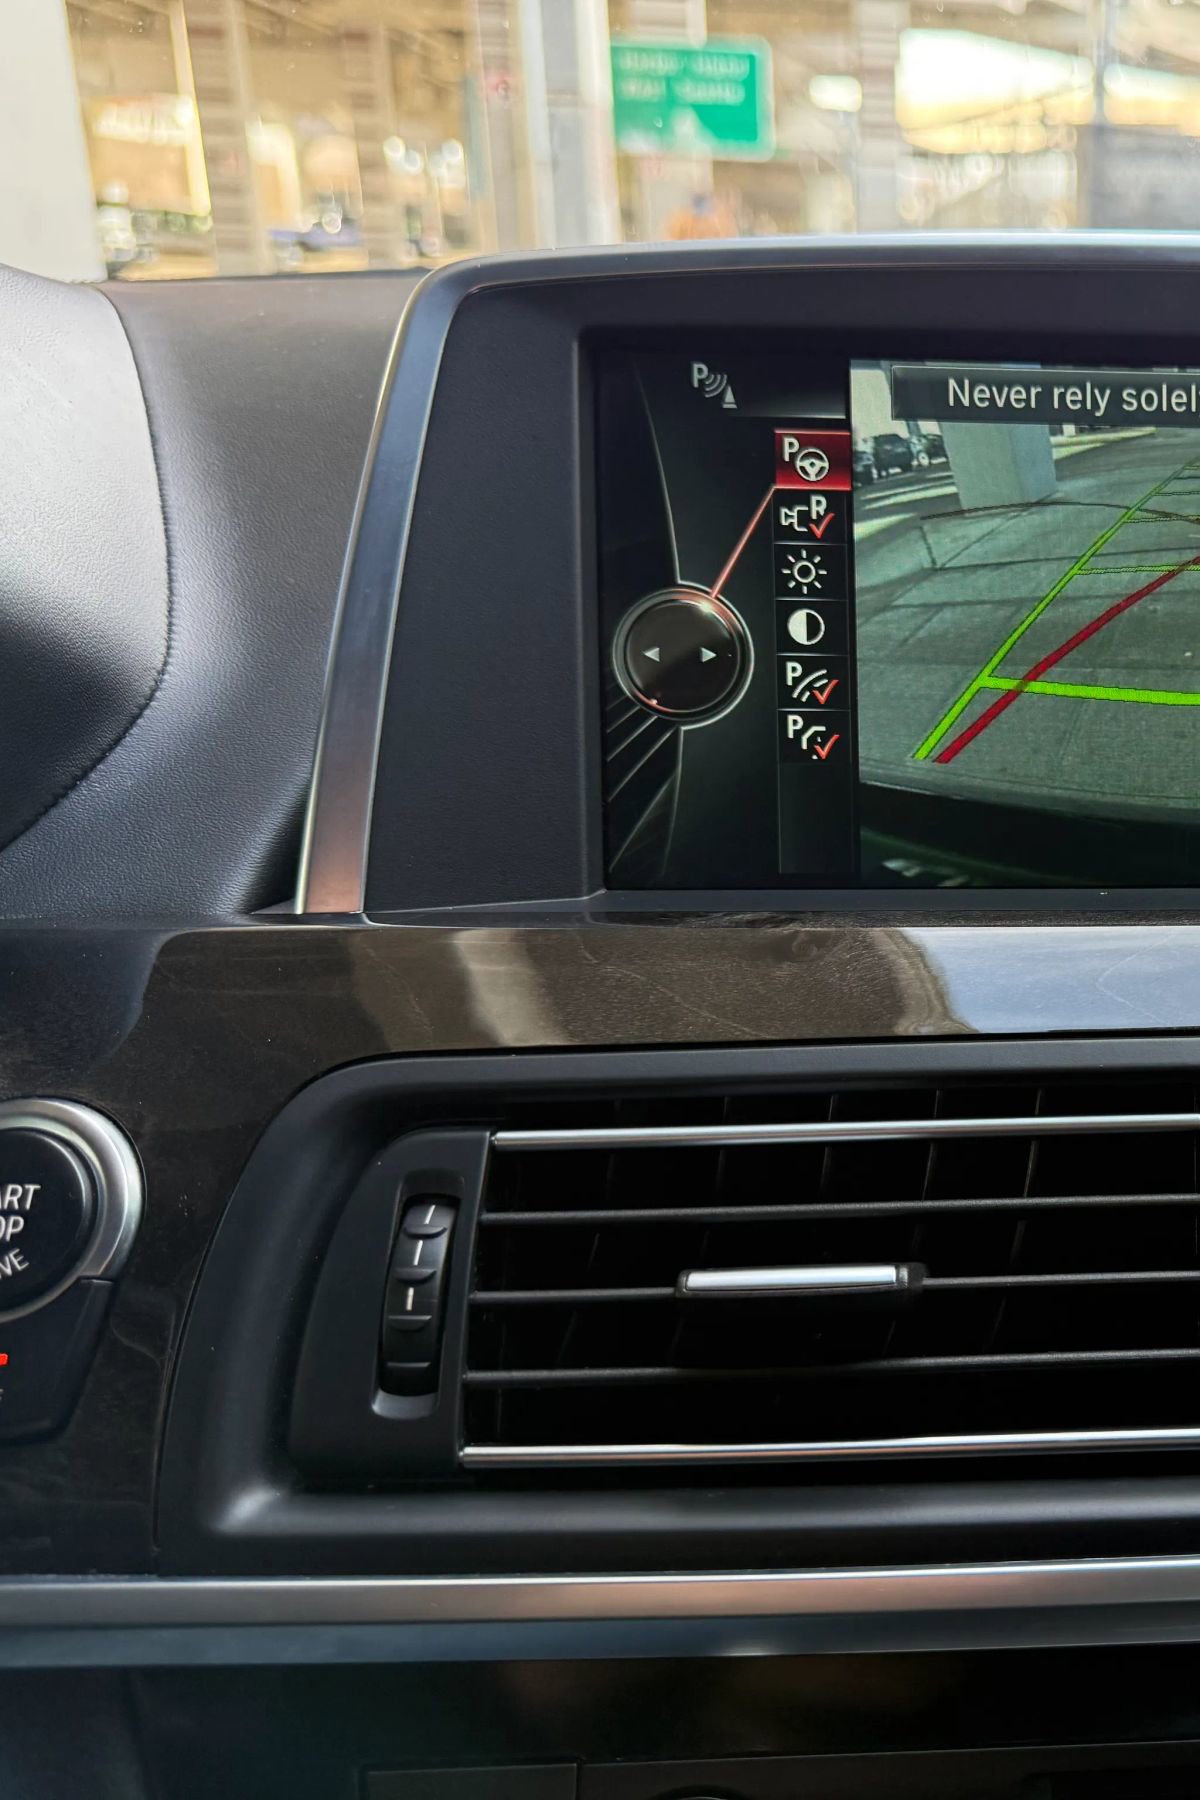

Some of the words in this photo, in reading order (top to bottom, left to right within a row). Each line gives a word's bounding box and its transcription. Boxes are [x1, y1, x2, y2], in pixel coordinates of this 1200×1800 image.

[690, 362, 708, 388] P
[947, 376, 1042, 409] Never
[1053, 380, 1111, 417] rely
[782, 435, 801, 462] P
[785, 660, 803, 686] P
[786, 713, 804, 739] P
[0, 1183, 41, 1210] RT
